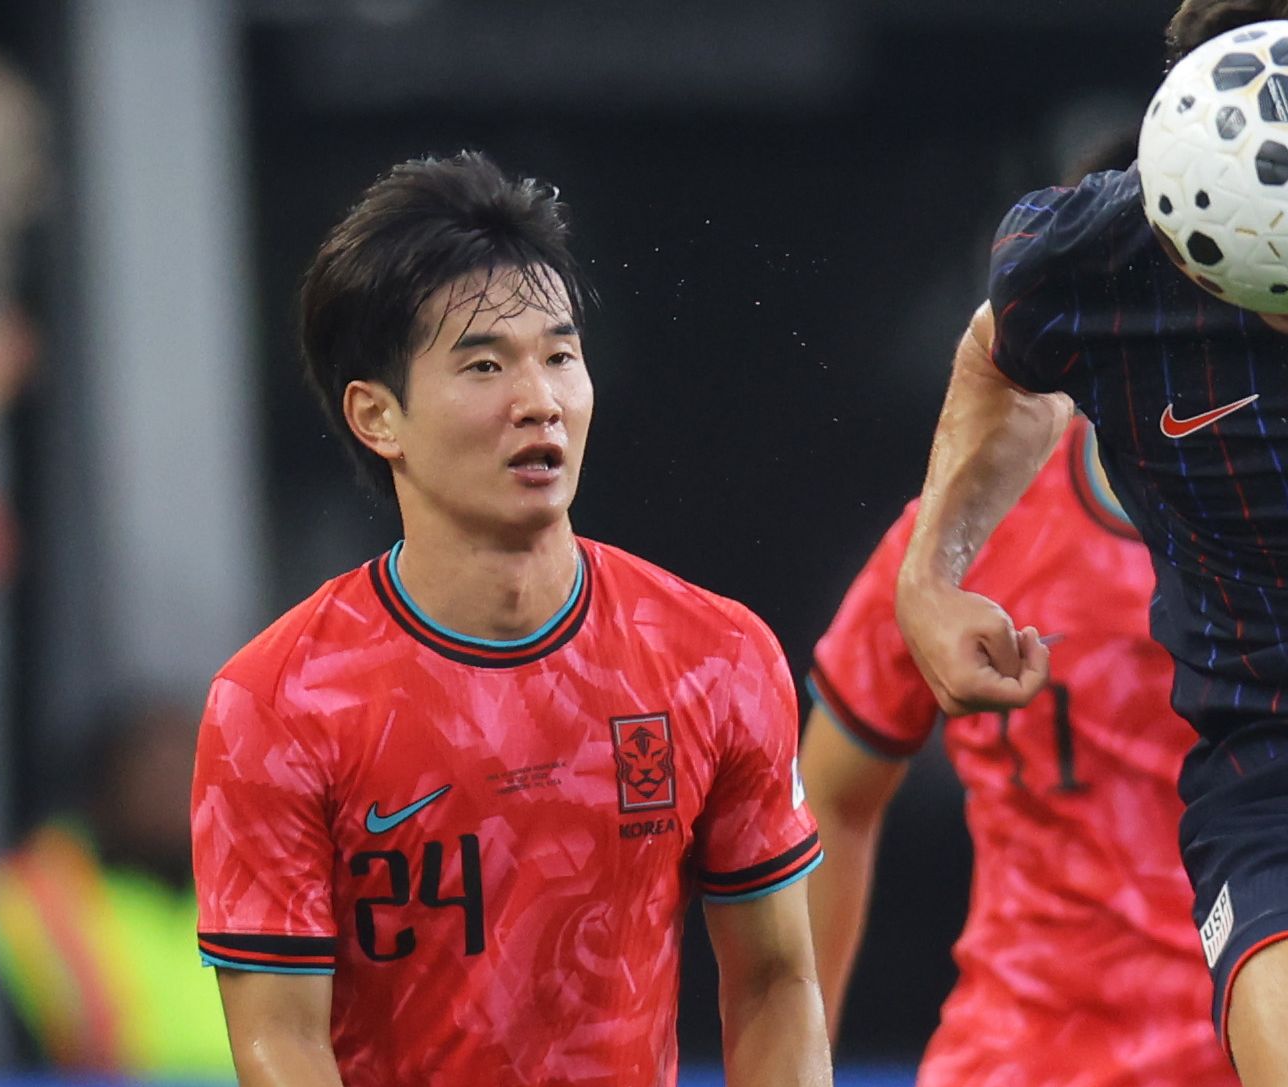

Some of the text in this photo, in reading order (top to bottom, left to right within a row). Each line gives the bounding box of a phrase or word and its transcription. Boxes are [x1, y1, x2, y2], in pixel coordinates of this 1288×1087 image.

[619, 818, 675, 839] KOREA
[351, 834, 484, 962] 24
[1203, 890, 1228, 942] USA
